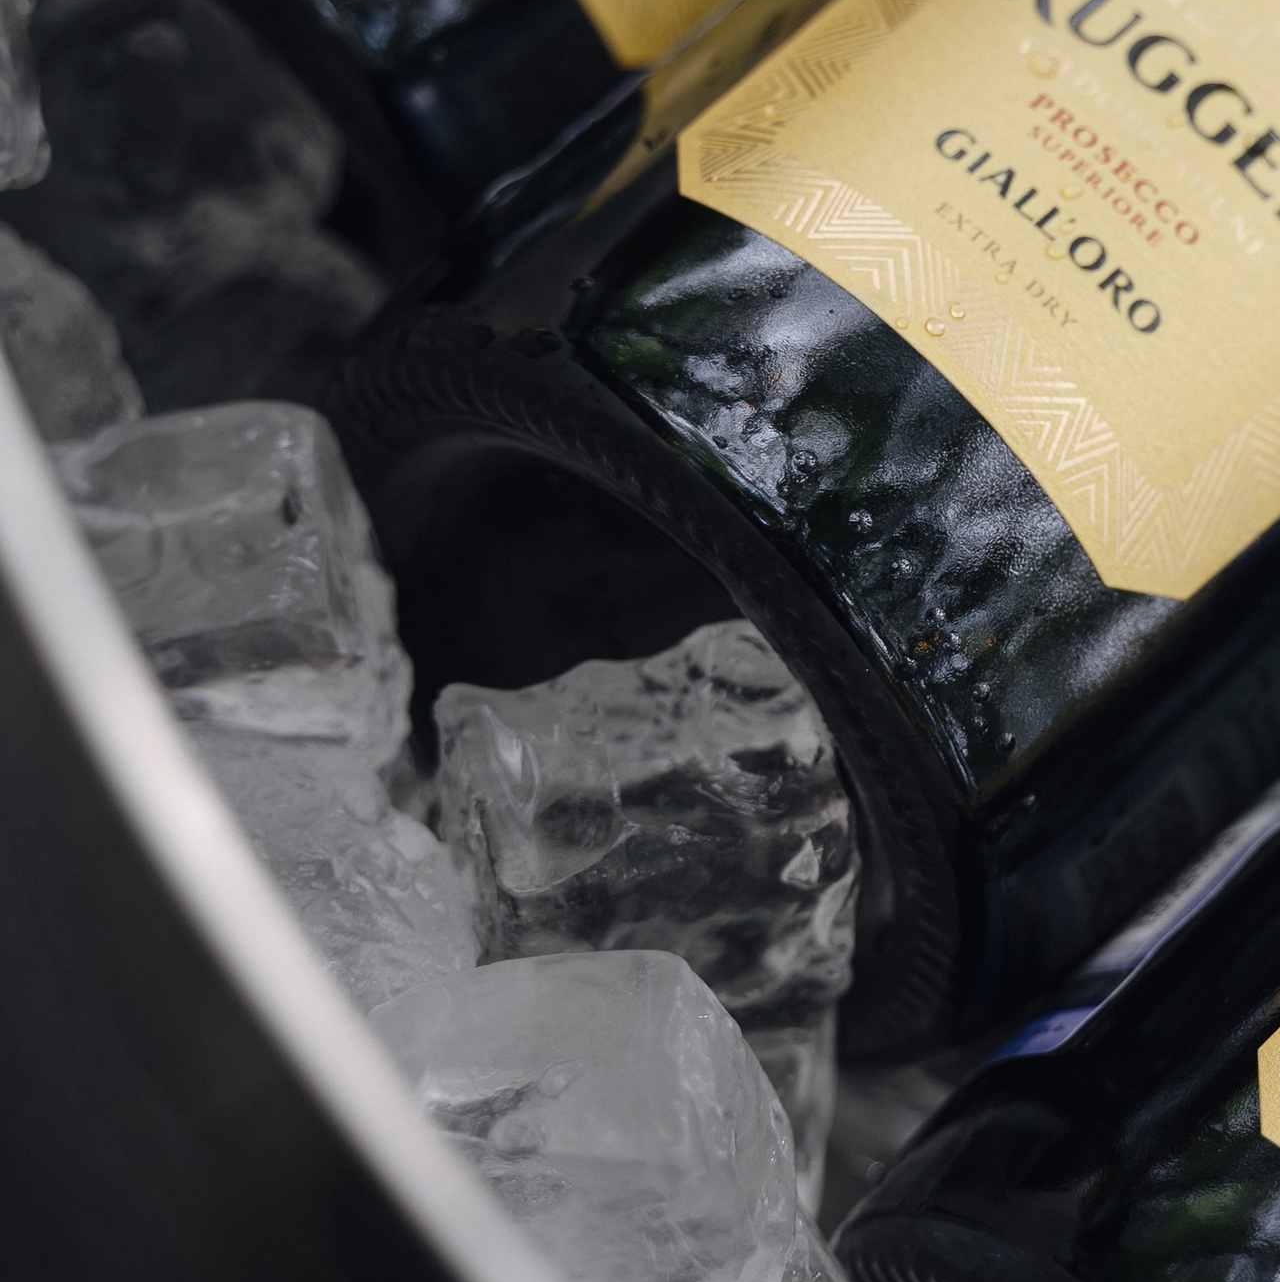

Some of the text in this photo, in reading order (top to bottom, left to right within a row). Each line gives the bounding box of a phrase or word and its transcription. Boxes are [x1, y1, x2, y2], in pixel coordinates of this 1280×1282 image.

[934, 126, 1163, 337] GIALL'ORO
[1026, 124, 1164, 250] SUPERIORE
[1027, 91, 1202, 249] PROSECCO
[934, 199, 1079, 332] EXTRA DRY
